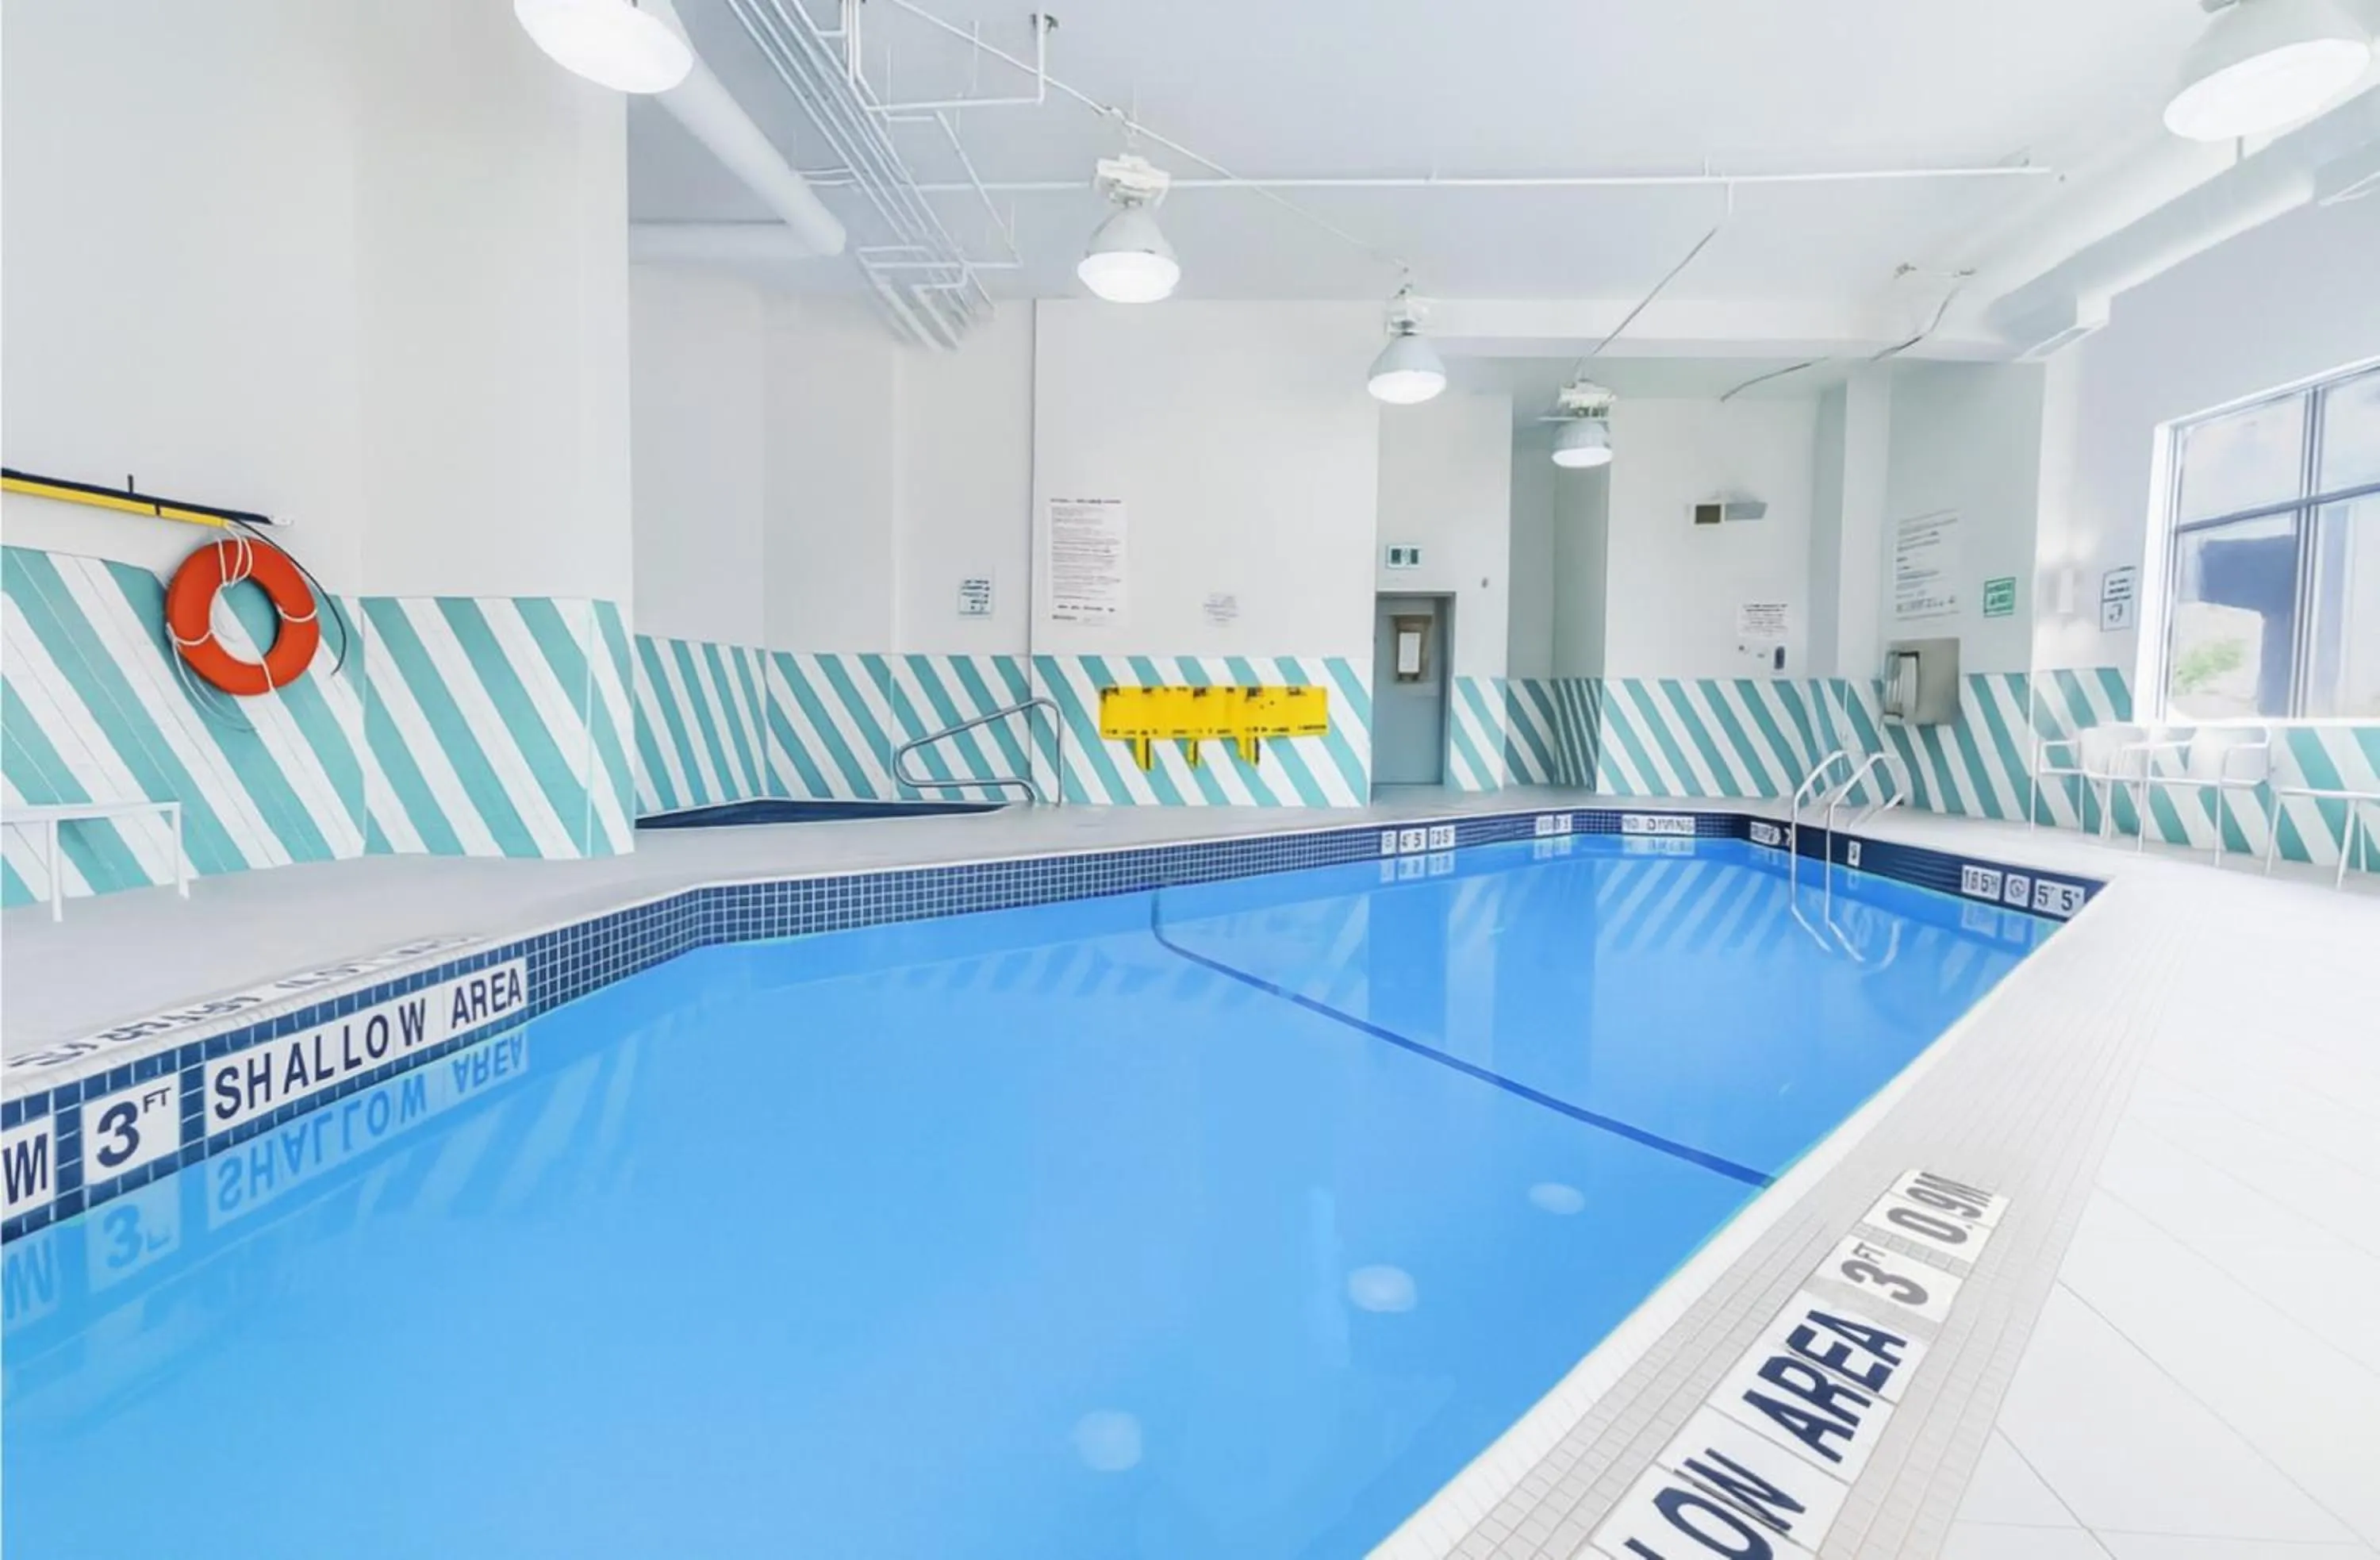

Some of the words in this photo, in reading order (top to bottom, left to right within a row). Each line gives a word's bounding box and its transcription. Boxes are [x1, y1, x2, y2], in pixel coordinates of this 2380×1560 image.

[214, 998, 426, 1120] SHALLOW
[451, 967, 523, 1028] AREA
[1742, 1309, 1907, 1464] AREA
